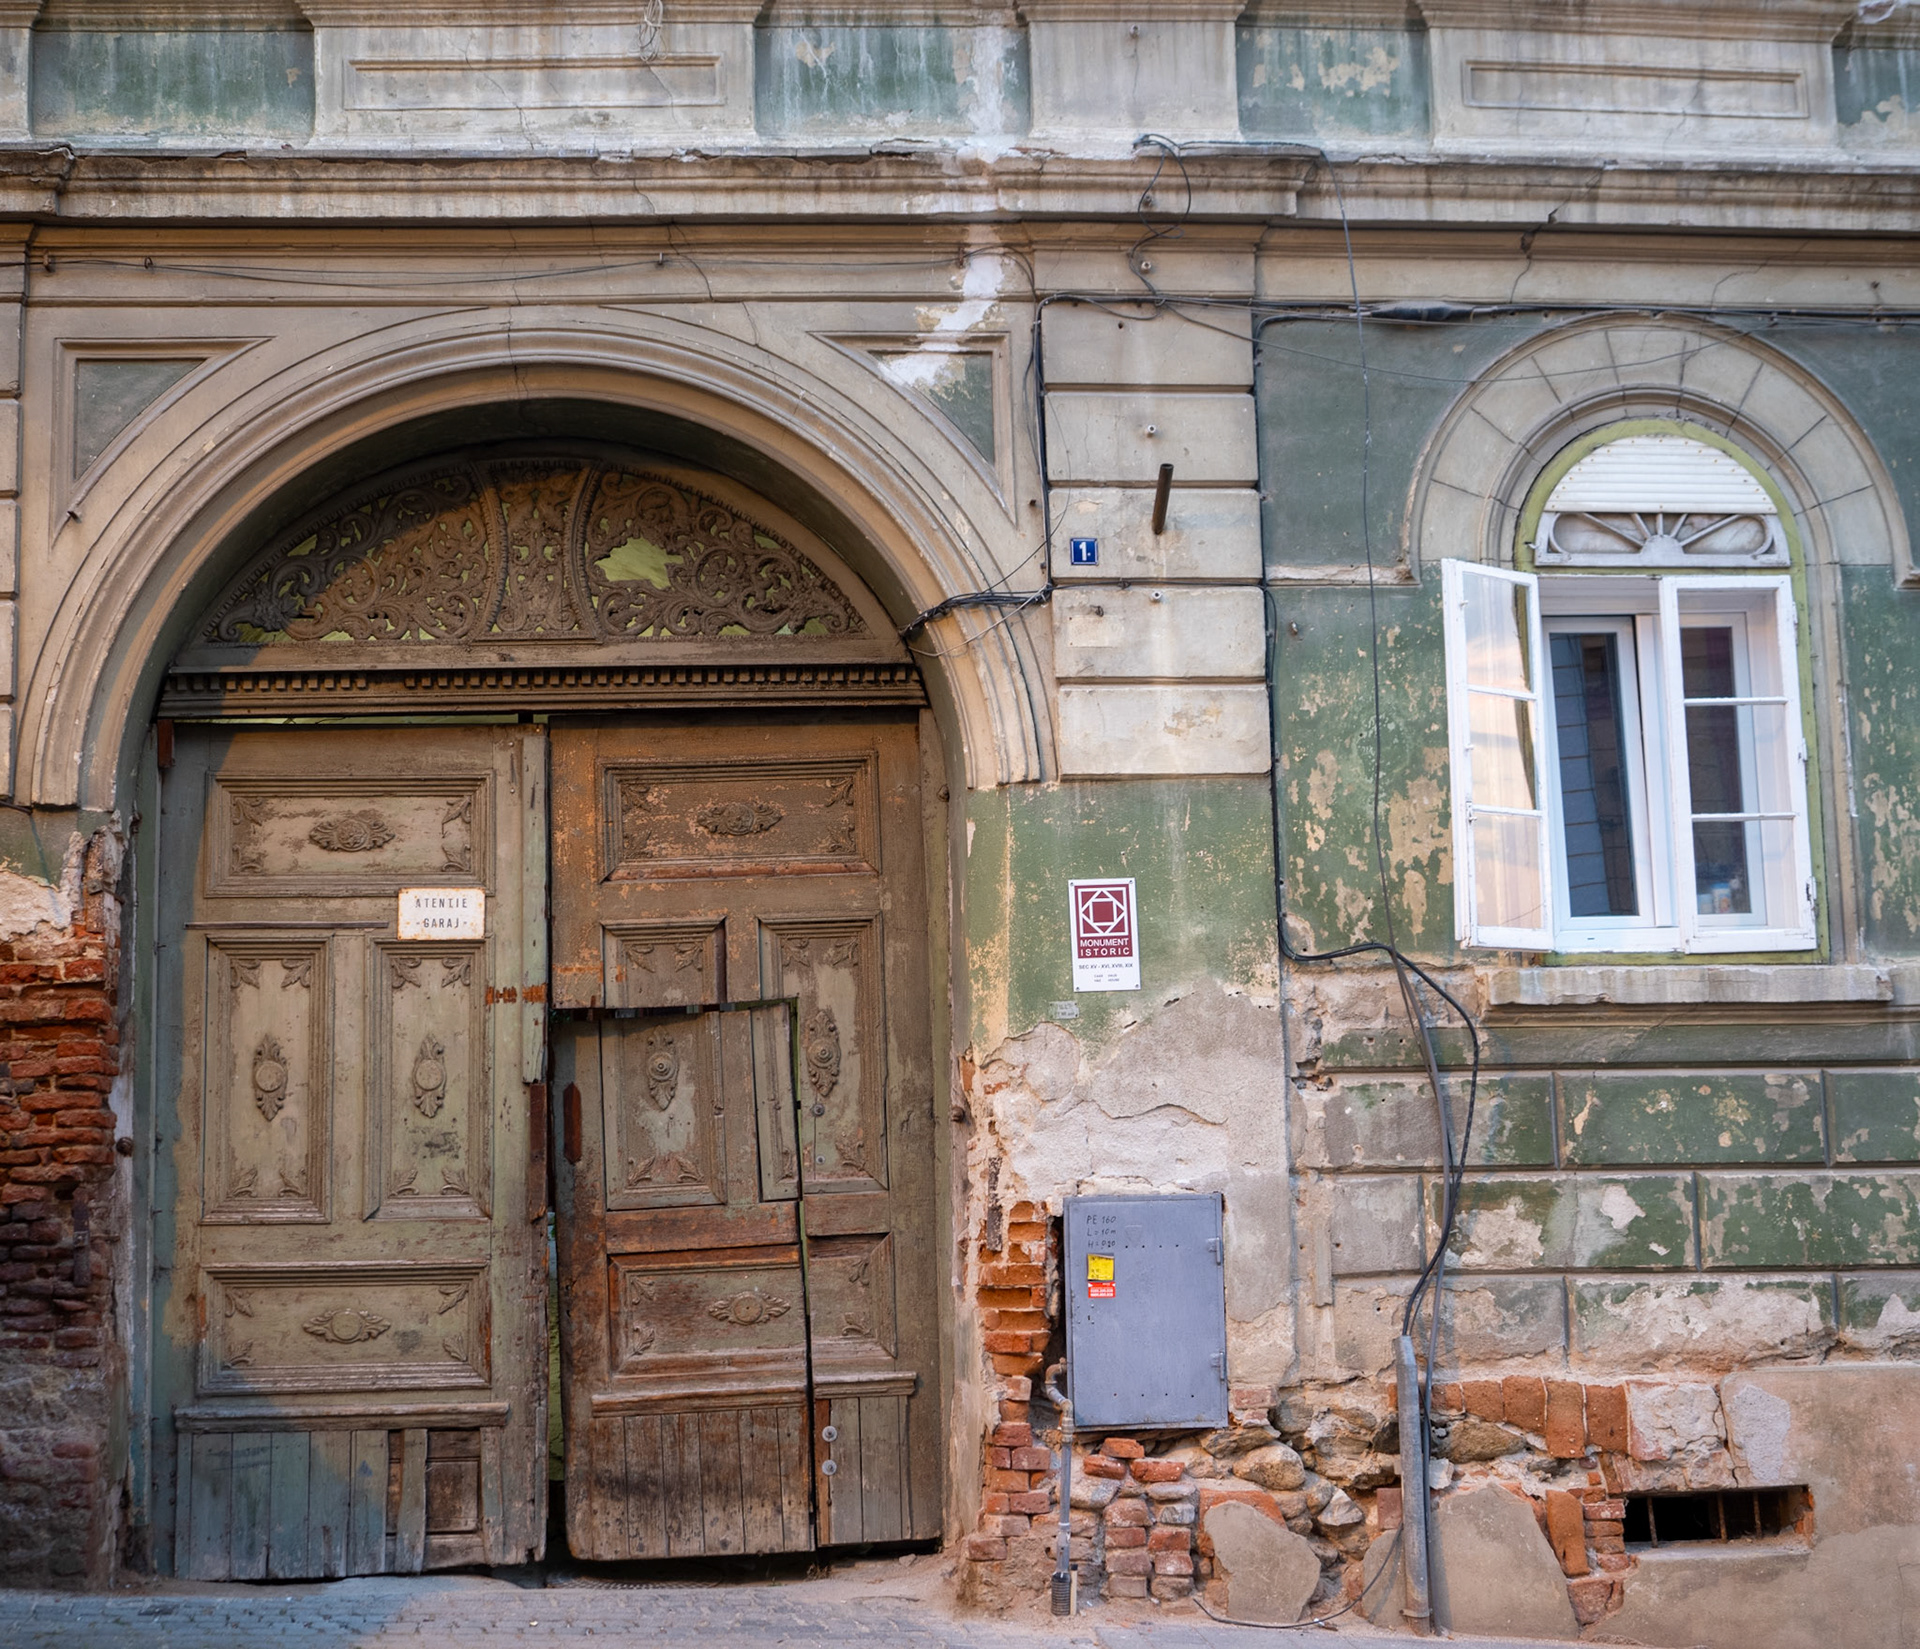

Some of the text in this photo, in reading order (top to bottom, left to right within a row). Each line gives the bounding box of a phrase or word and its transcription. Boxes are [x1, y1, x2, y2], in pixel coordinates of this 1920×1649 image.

[1080, 938, 1129, 947] MONUMENT
[1080, 947, 1130, 957] ISTORIC
[1086, 1214, 1117, 1225] PE 160
